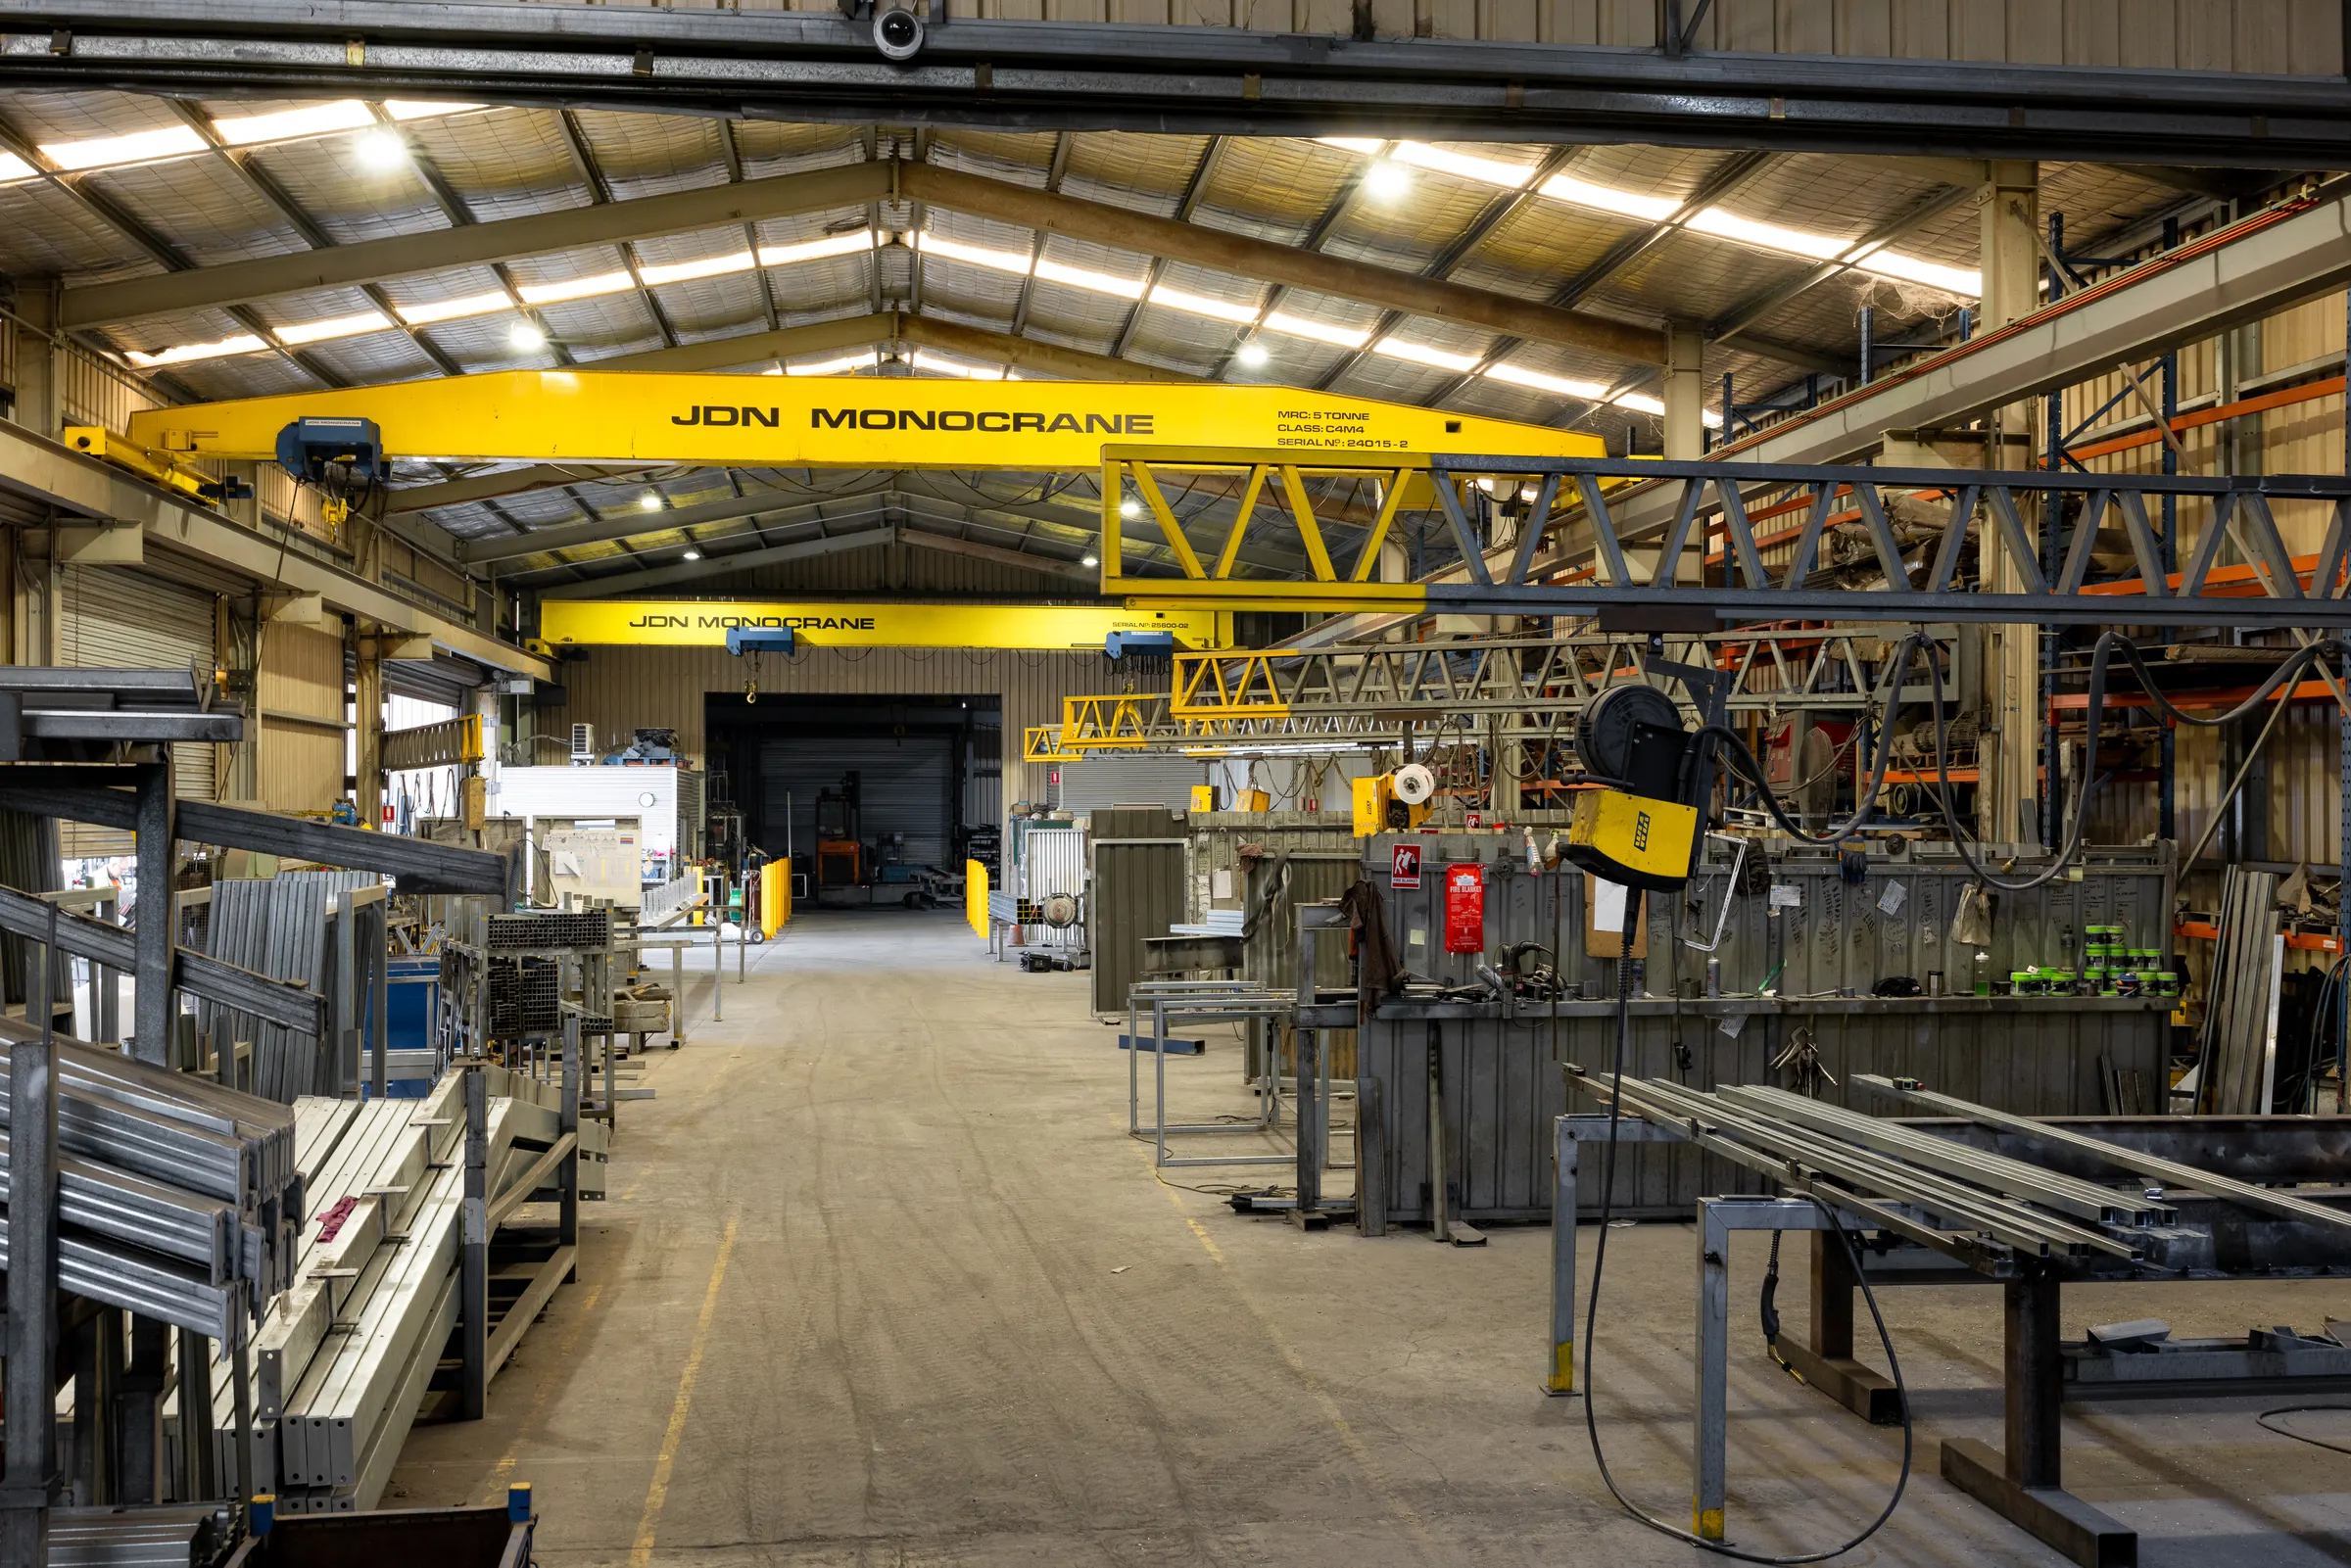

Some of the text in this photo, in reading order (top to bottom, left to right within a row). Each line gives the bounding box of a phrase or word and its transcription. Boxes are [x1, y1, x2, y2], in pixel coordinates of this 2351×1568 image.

[672, 405, 1154, 434] JDN MONOCRANE
[1277, 424, 1365, 434] CLASS: C4M4
[1277, 438, 1322, 447] SERIAL
[629, 615, 875, 629] JDN MONOCRANE
